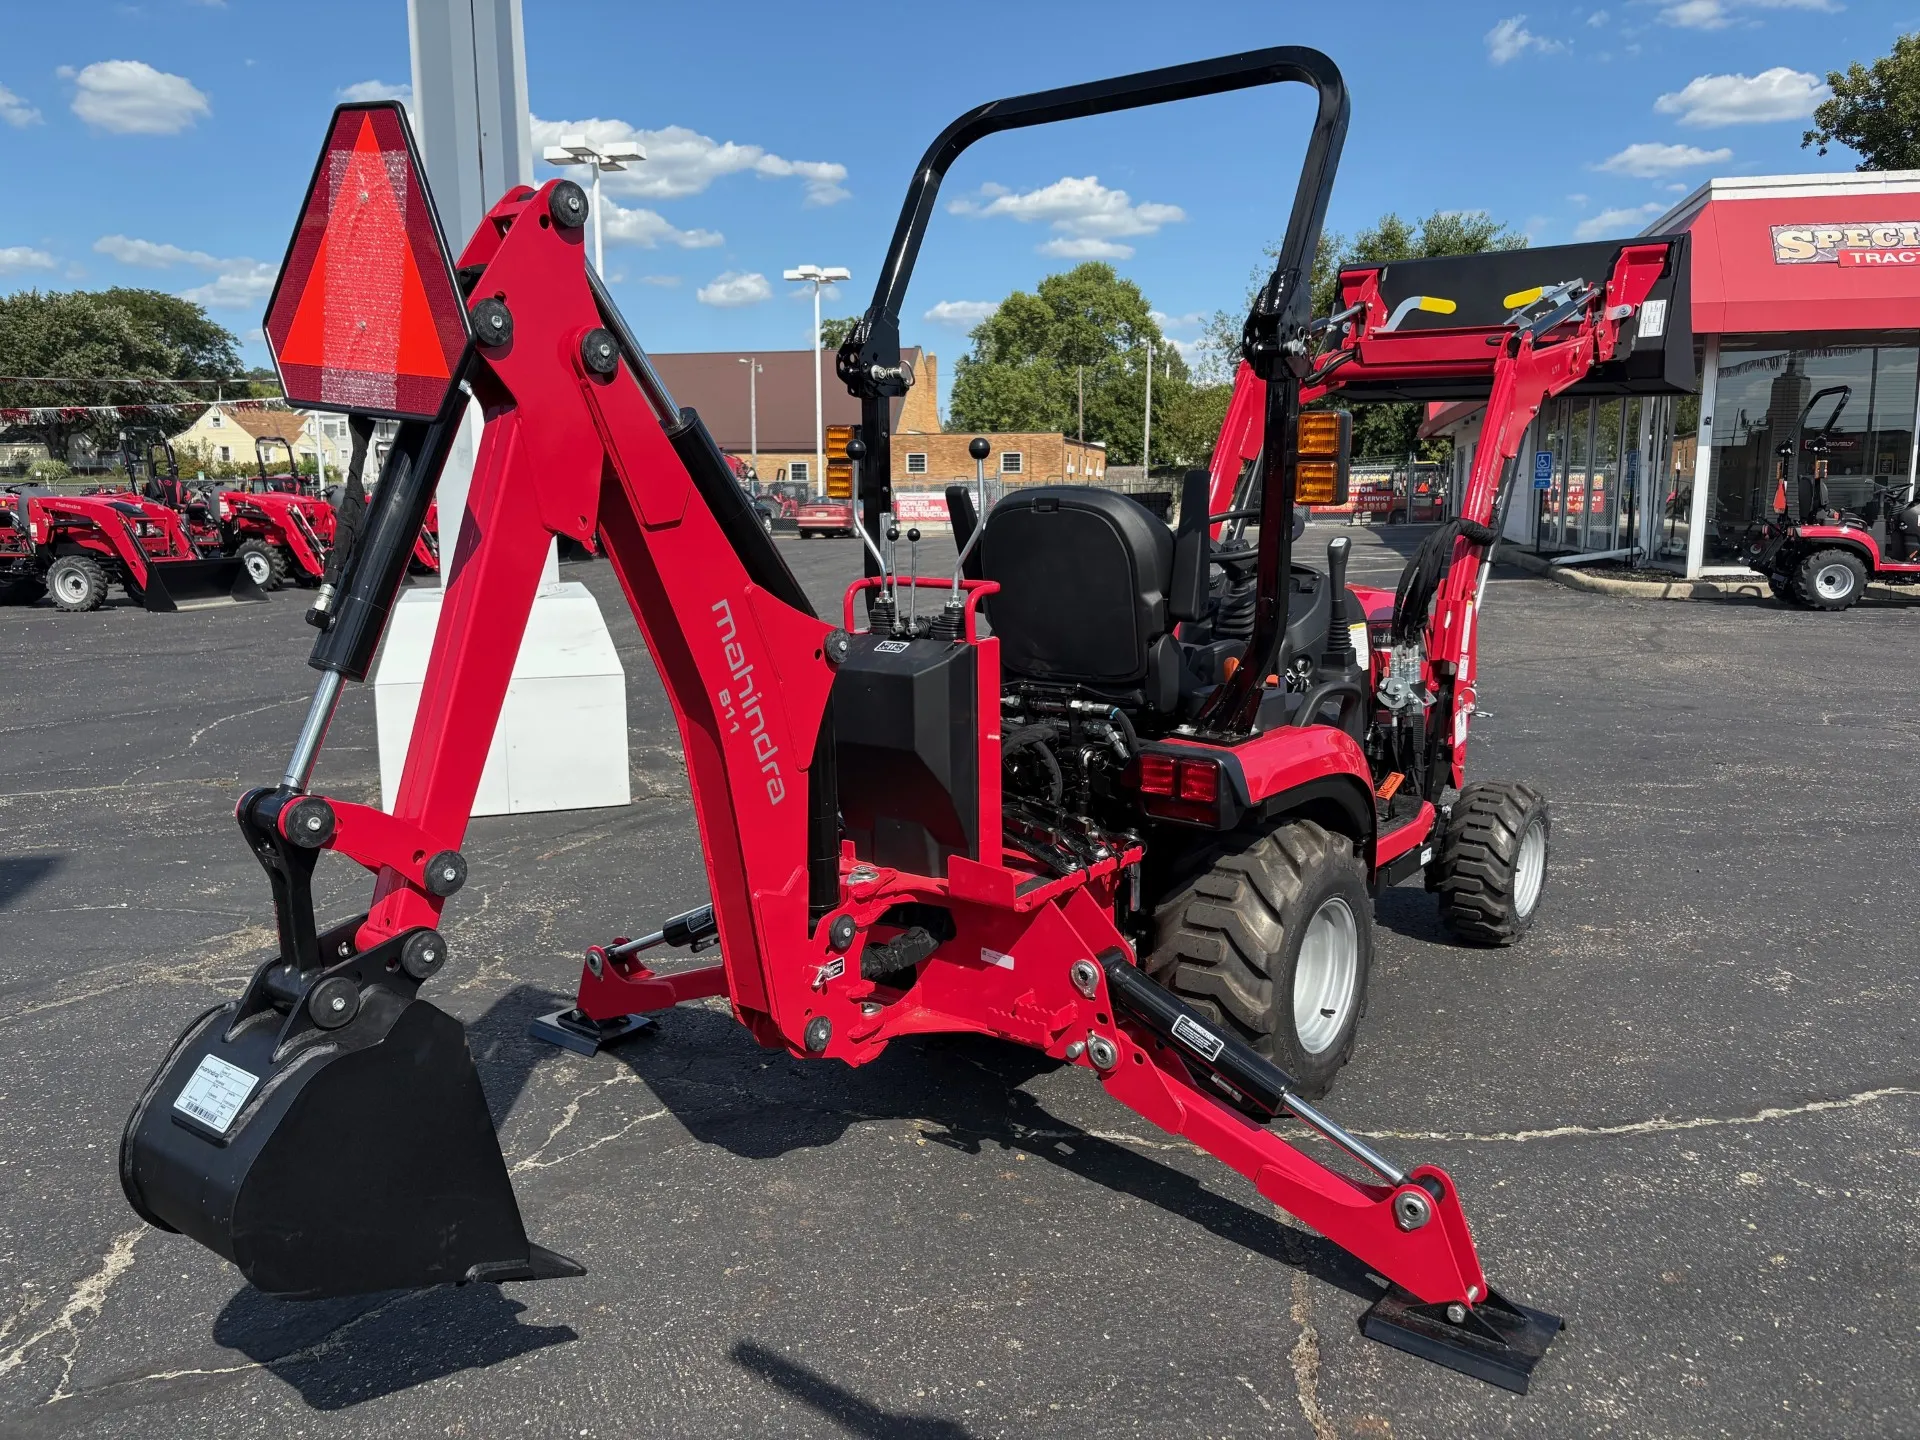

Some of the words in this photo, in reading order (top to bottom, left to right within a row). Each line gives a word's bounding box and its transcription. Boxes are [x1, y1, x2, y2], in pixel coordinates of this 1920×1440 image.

[1776, 227, 1920, 260] SPECI
[1850, 251, 1920, 265] TRAC
[711, 598, 786, 806] mahindra
[718, 688, 740, 734] B11
